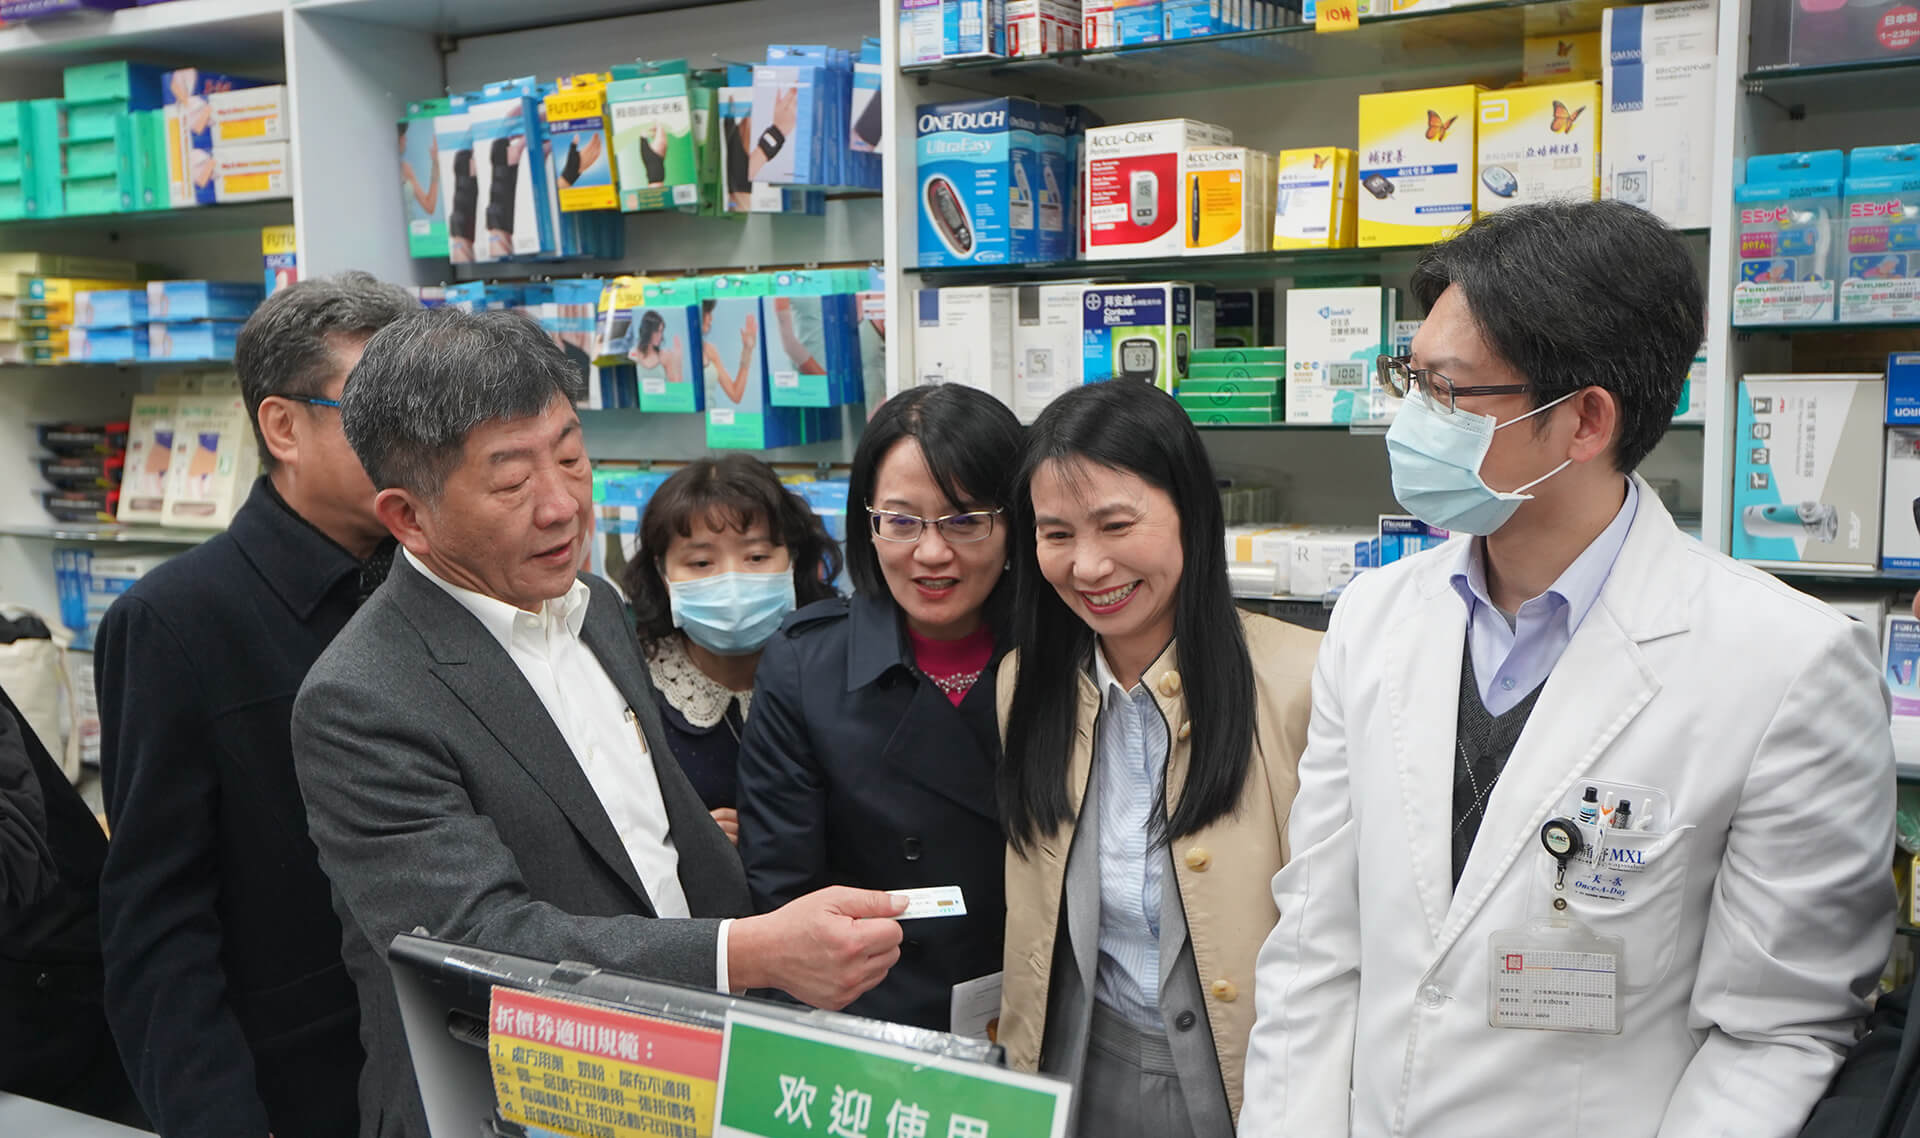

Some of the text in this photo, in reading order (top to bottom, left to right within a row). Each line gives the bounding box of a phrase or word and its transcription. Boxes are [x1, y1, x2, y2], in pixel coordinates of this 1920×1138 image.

[266, 232, 295, 246] FUTU
[1609, 848, 1646, 864] MXL
[1575, 880, 1628, 896] Once-A-Day
